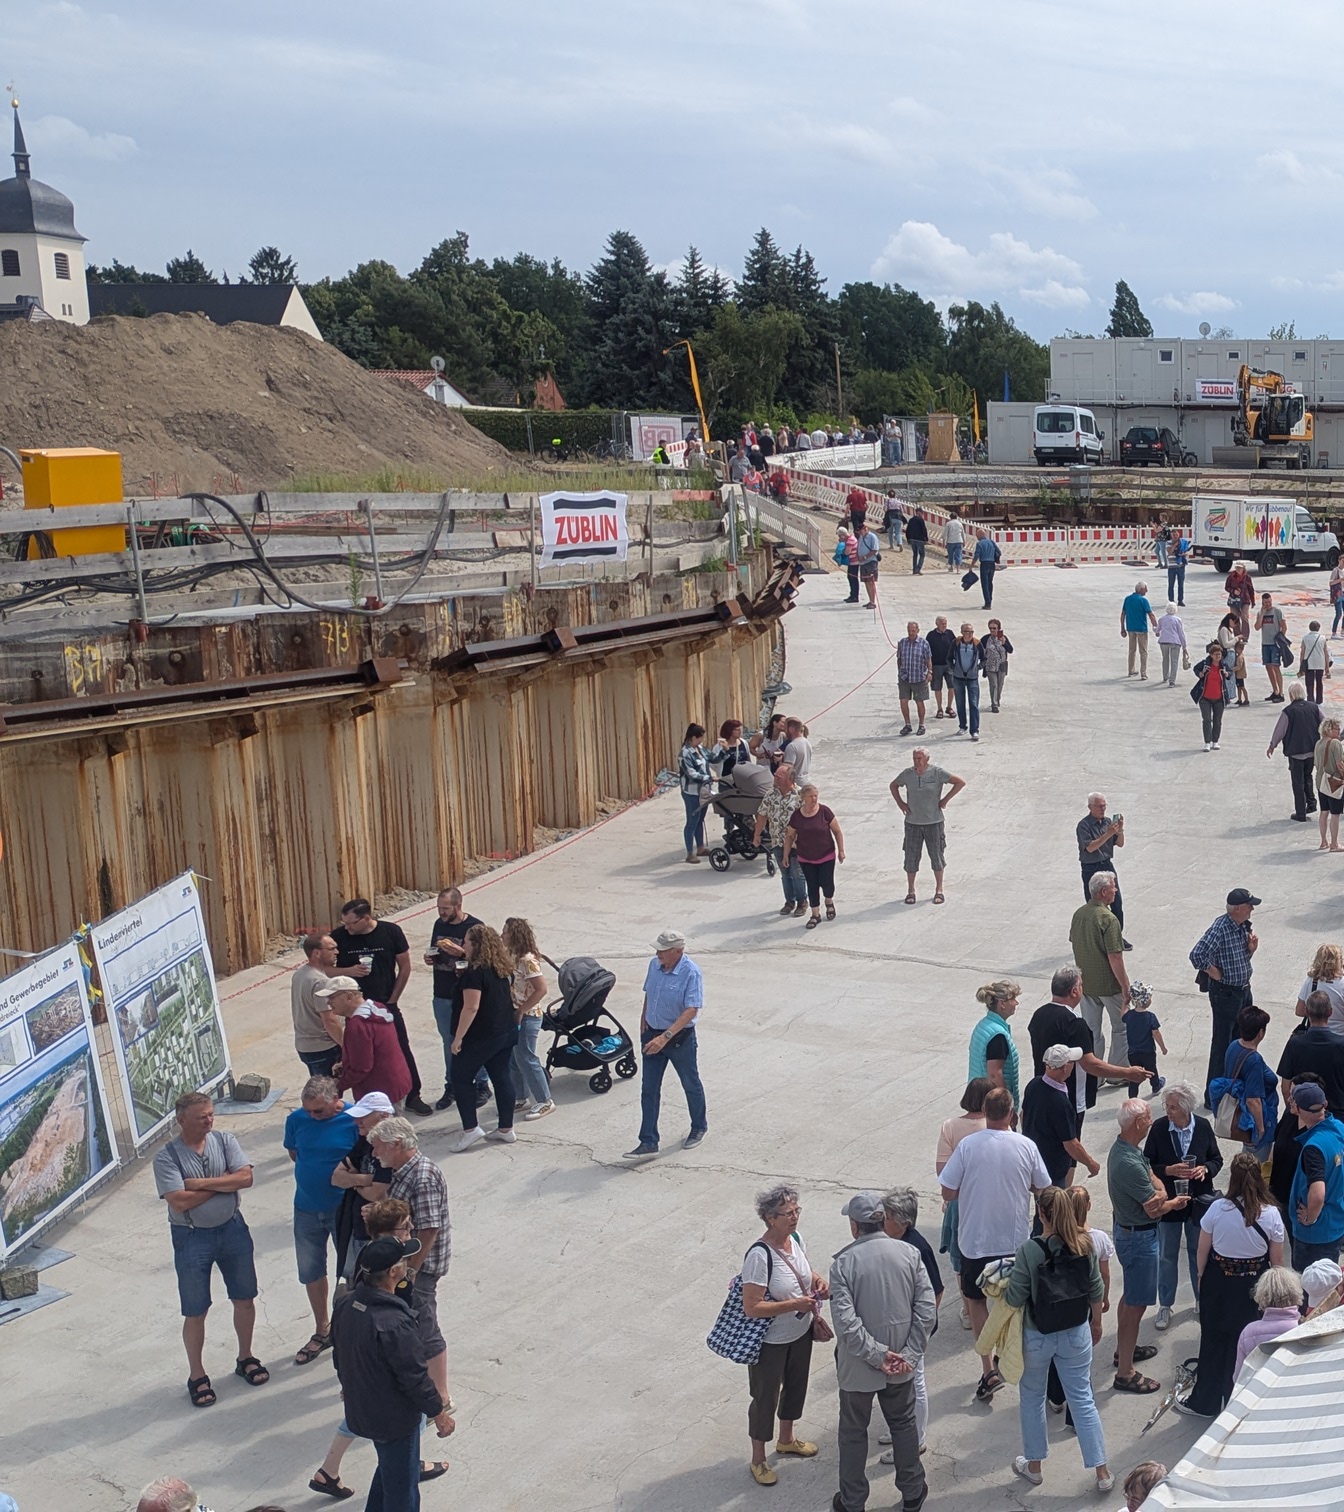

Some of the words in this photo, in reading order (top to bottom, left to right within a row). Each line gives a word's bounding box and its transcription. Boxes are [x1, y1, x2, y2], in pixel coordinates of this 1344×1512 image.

[1202, 386, 1234, 395] ZÜBLIN
[554, 514, 618, 545] ZÜBLIN
[97, 915, 143, 950] Lindenviertel
[9, 968, 59, 1005] Gewerbegebiet
